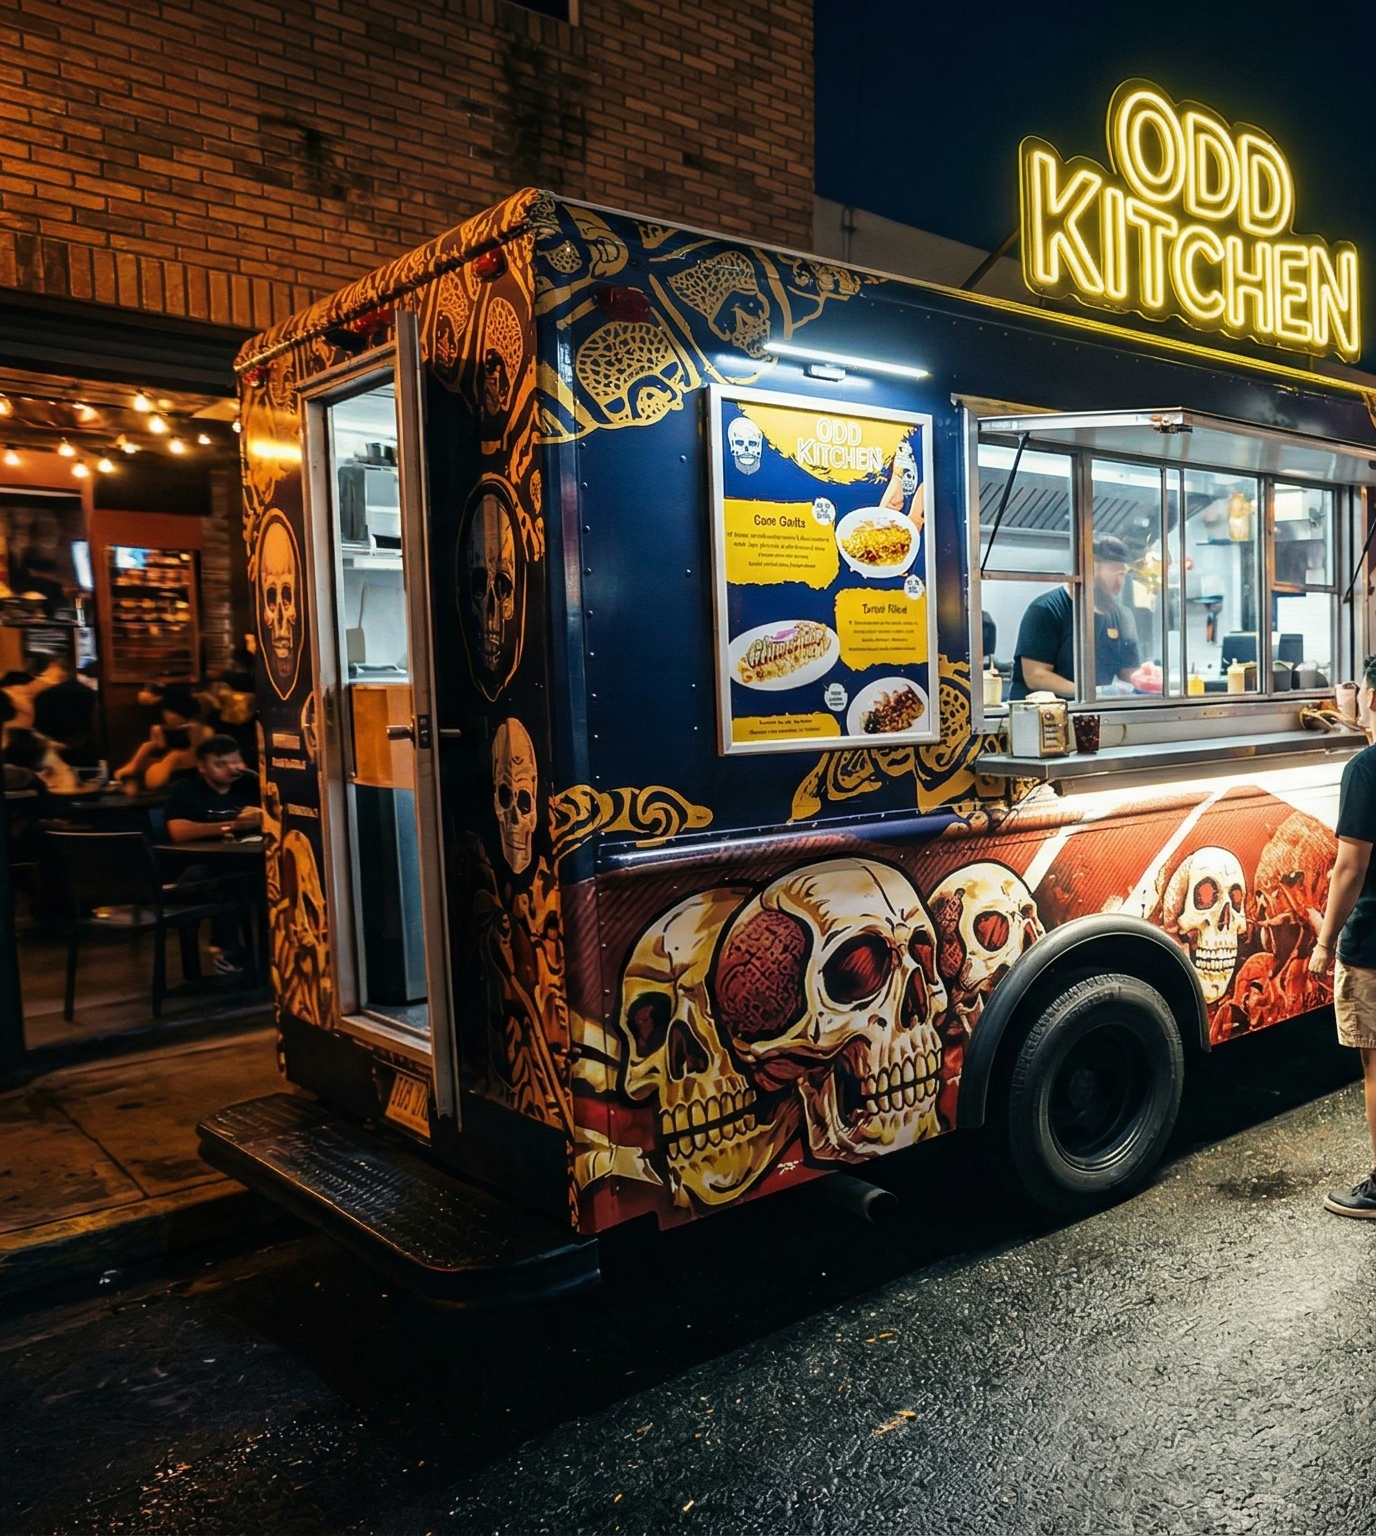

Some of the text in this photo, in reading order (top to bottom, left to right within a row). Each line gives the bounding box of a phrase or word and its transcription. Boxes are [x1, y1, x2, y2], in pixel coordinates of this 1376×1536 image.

[1115, 90, 1292, 237] ODD
[1027, 150, 1358, 352] KITCHEN
[797, 437, 882, 472] KITCHEN
[816, 417, 862, 446] ODD
